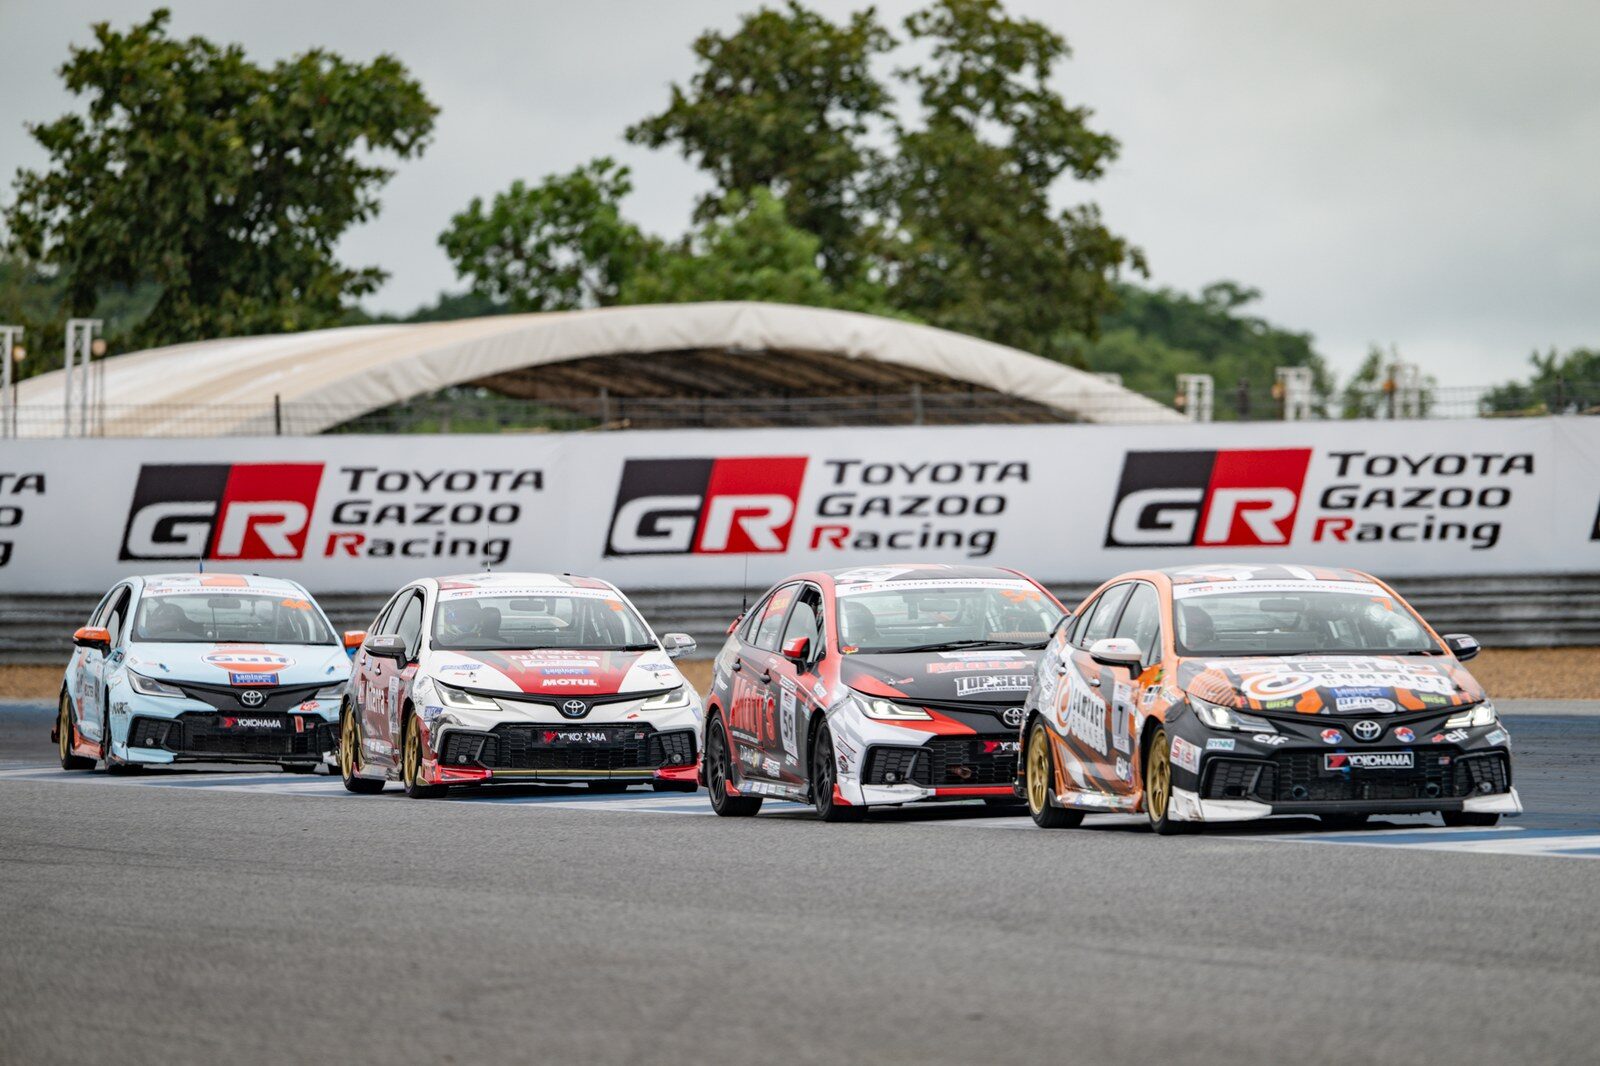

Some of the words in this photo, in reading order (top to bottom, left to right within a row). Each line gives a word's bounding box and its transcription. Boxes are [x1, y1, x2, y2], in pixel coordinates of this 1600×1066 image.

[824, 460, 1030, 486] TOYOTA
[1327, 450, 1535, 476] TOYOTA
[340, 466, 544, 493] TOYOTA
[815, 493, 1008, 518] GAZOO
[1319, 485, 1511, 509] GAZOO
[331, 500, 521, 526] GAZOO
[808, 522, 998, 557] Racing
[1311, 515, 1501, 550] Racing
[323, 532, 512, 567] Racing
[542, 679, 597, 687] MOTUL
[957, 676, 987, 691] TOP
[995, 675, 1034, 687] SEC
[1320, 673, 1445, 685] COMPACT
[237, 718, 282, 728] YOKOHAMA
[1117, 705, 1125, 735] 7
[558, 732, 607, 742] YKOAMA
[1253, 733, 1289, 745] elf
[1445, 728, 1470, 743] elf
[1349, 754, 1412, 766] YOKOHAMA
